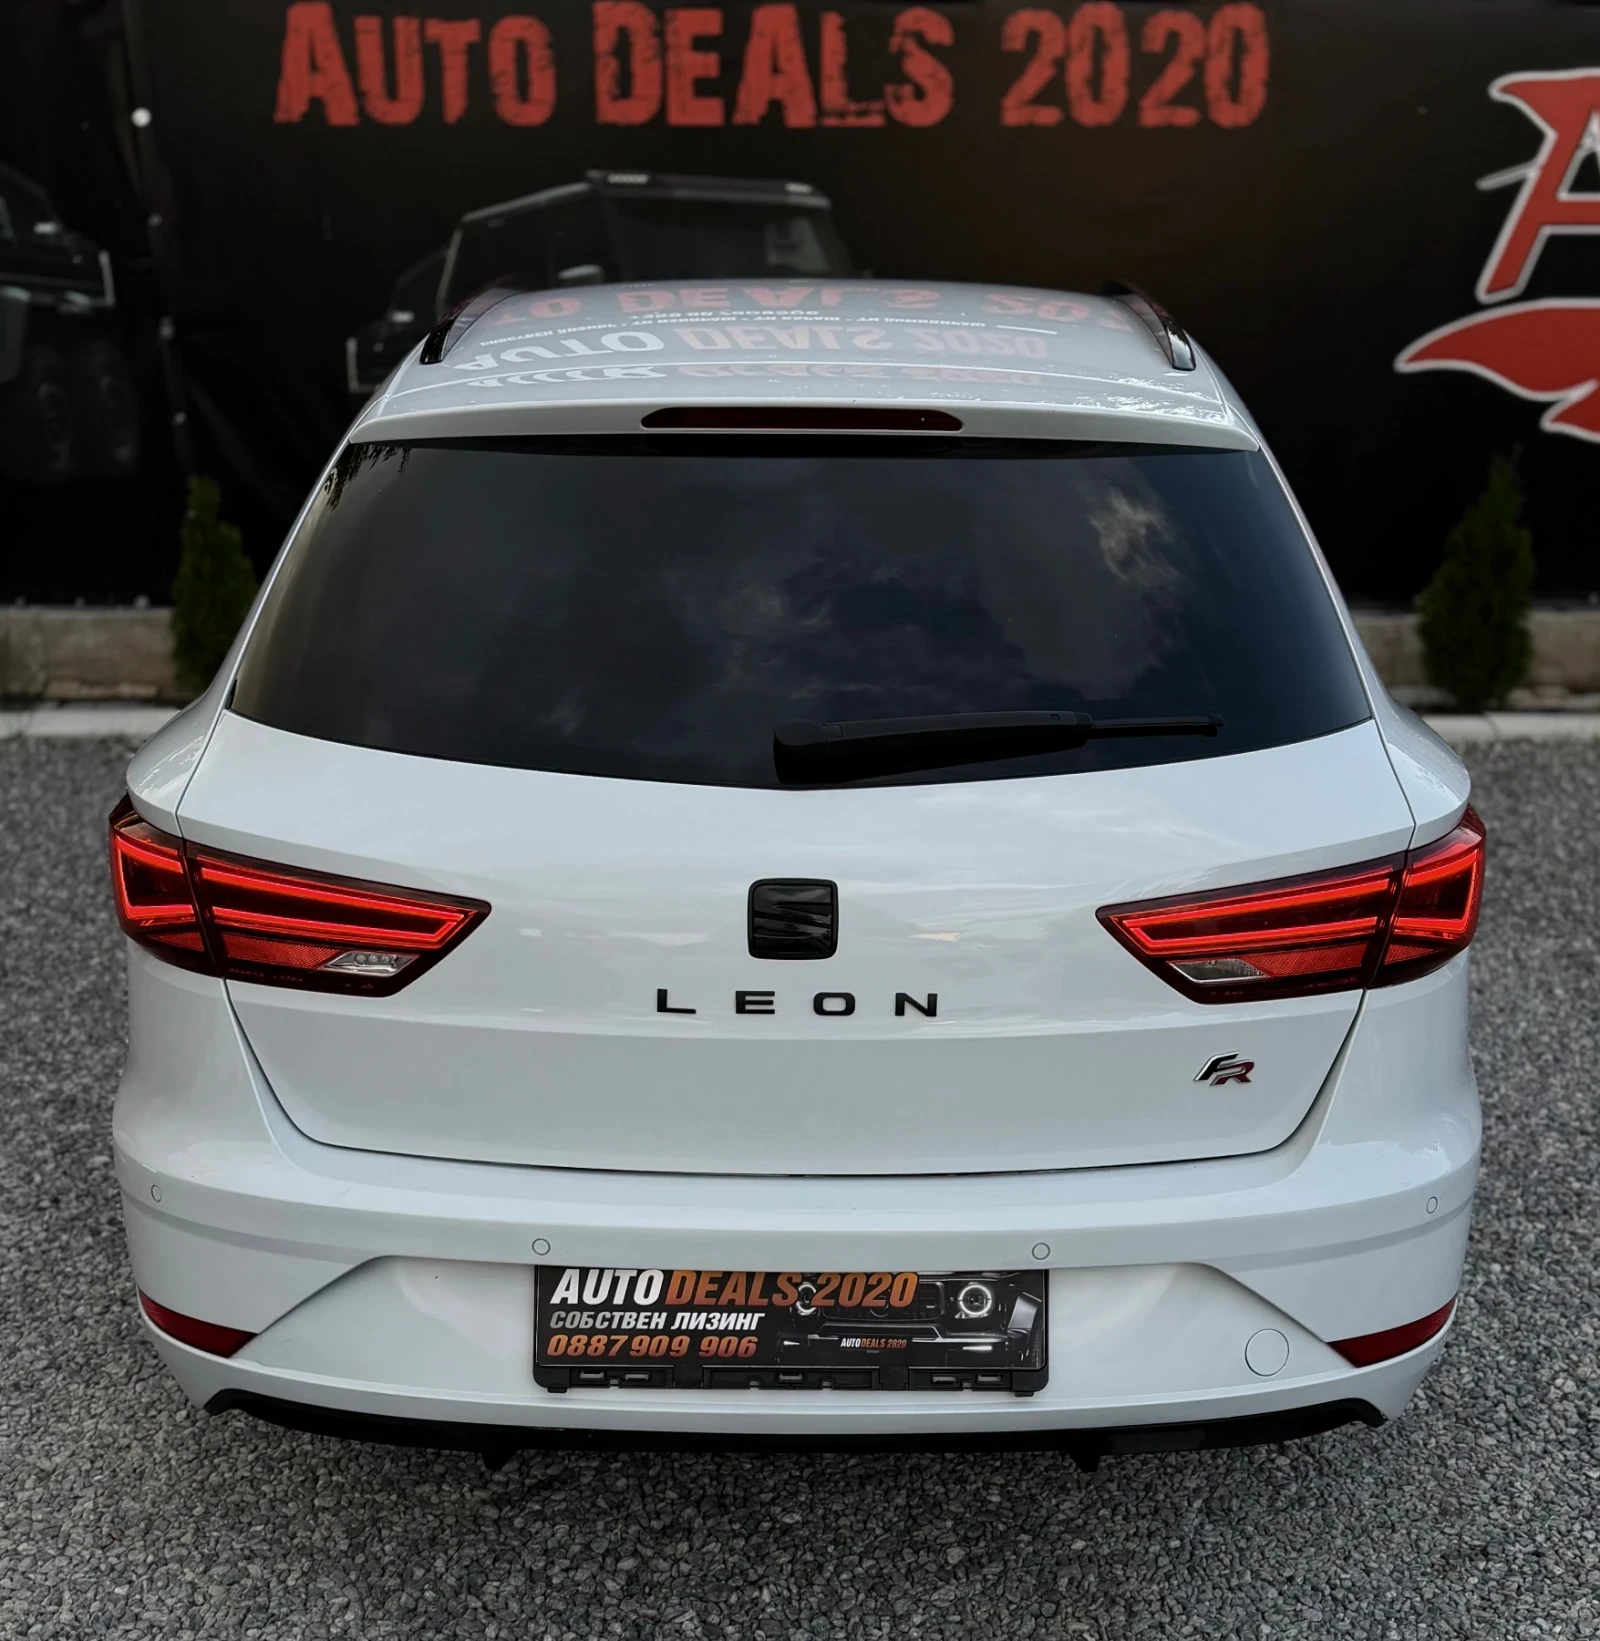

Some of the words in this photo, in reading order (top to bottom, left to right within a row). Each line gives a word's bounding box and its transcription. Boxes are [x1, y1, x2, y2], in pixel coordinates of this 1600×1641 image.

[274, 1, 557, 127] AUTO
[593, 1, 955, 128] DEALS
[1001, 2, 1270, 128] 2020
[656, 988, 938, 1018] LEON
[1193, 1049, 1255, 1087] FR
[810, 1271, 919, 1308] 2020
[550, 1311, 666, 1330] СОБСТВЕН
[670, 1312, 766, 1331] ЛИЗИНГ
[699, 1336, 759, 1358] 906
[886, 1338, 907, 1349] 2020
